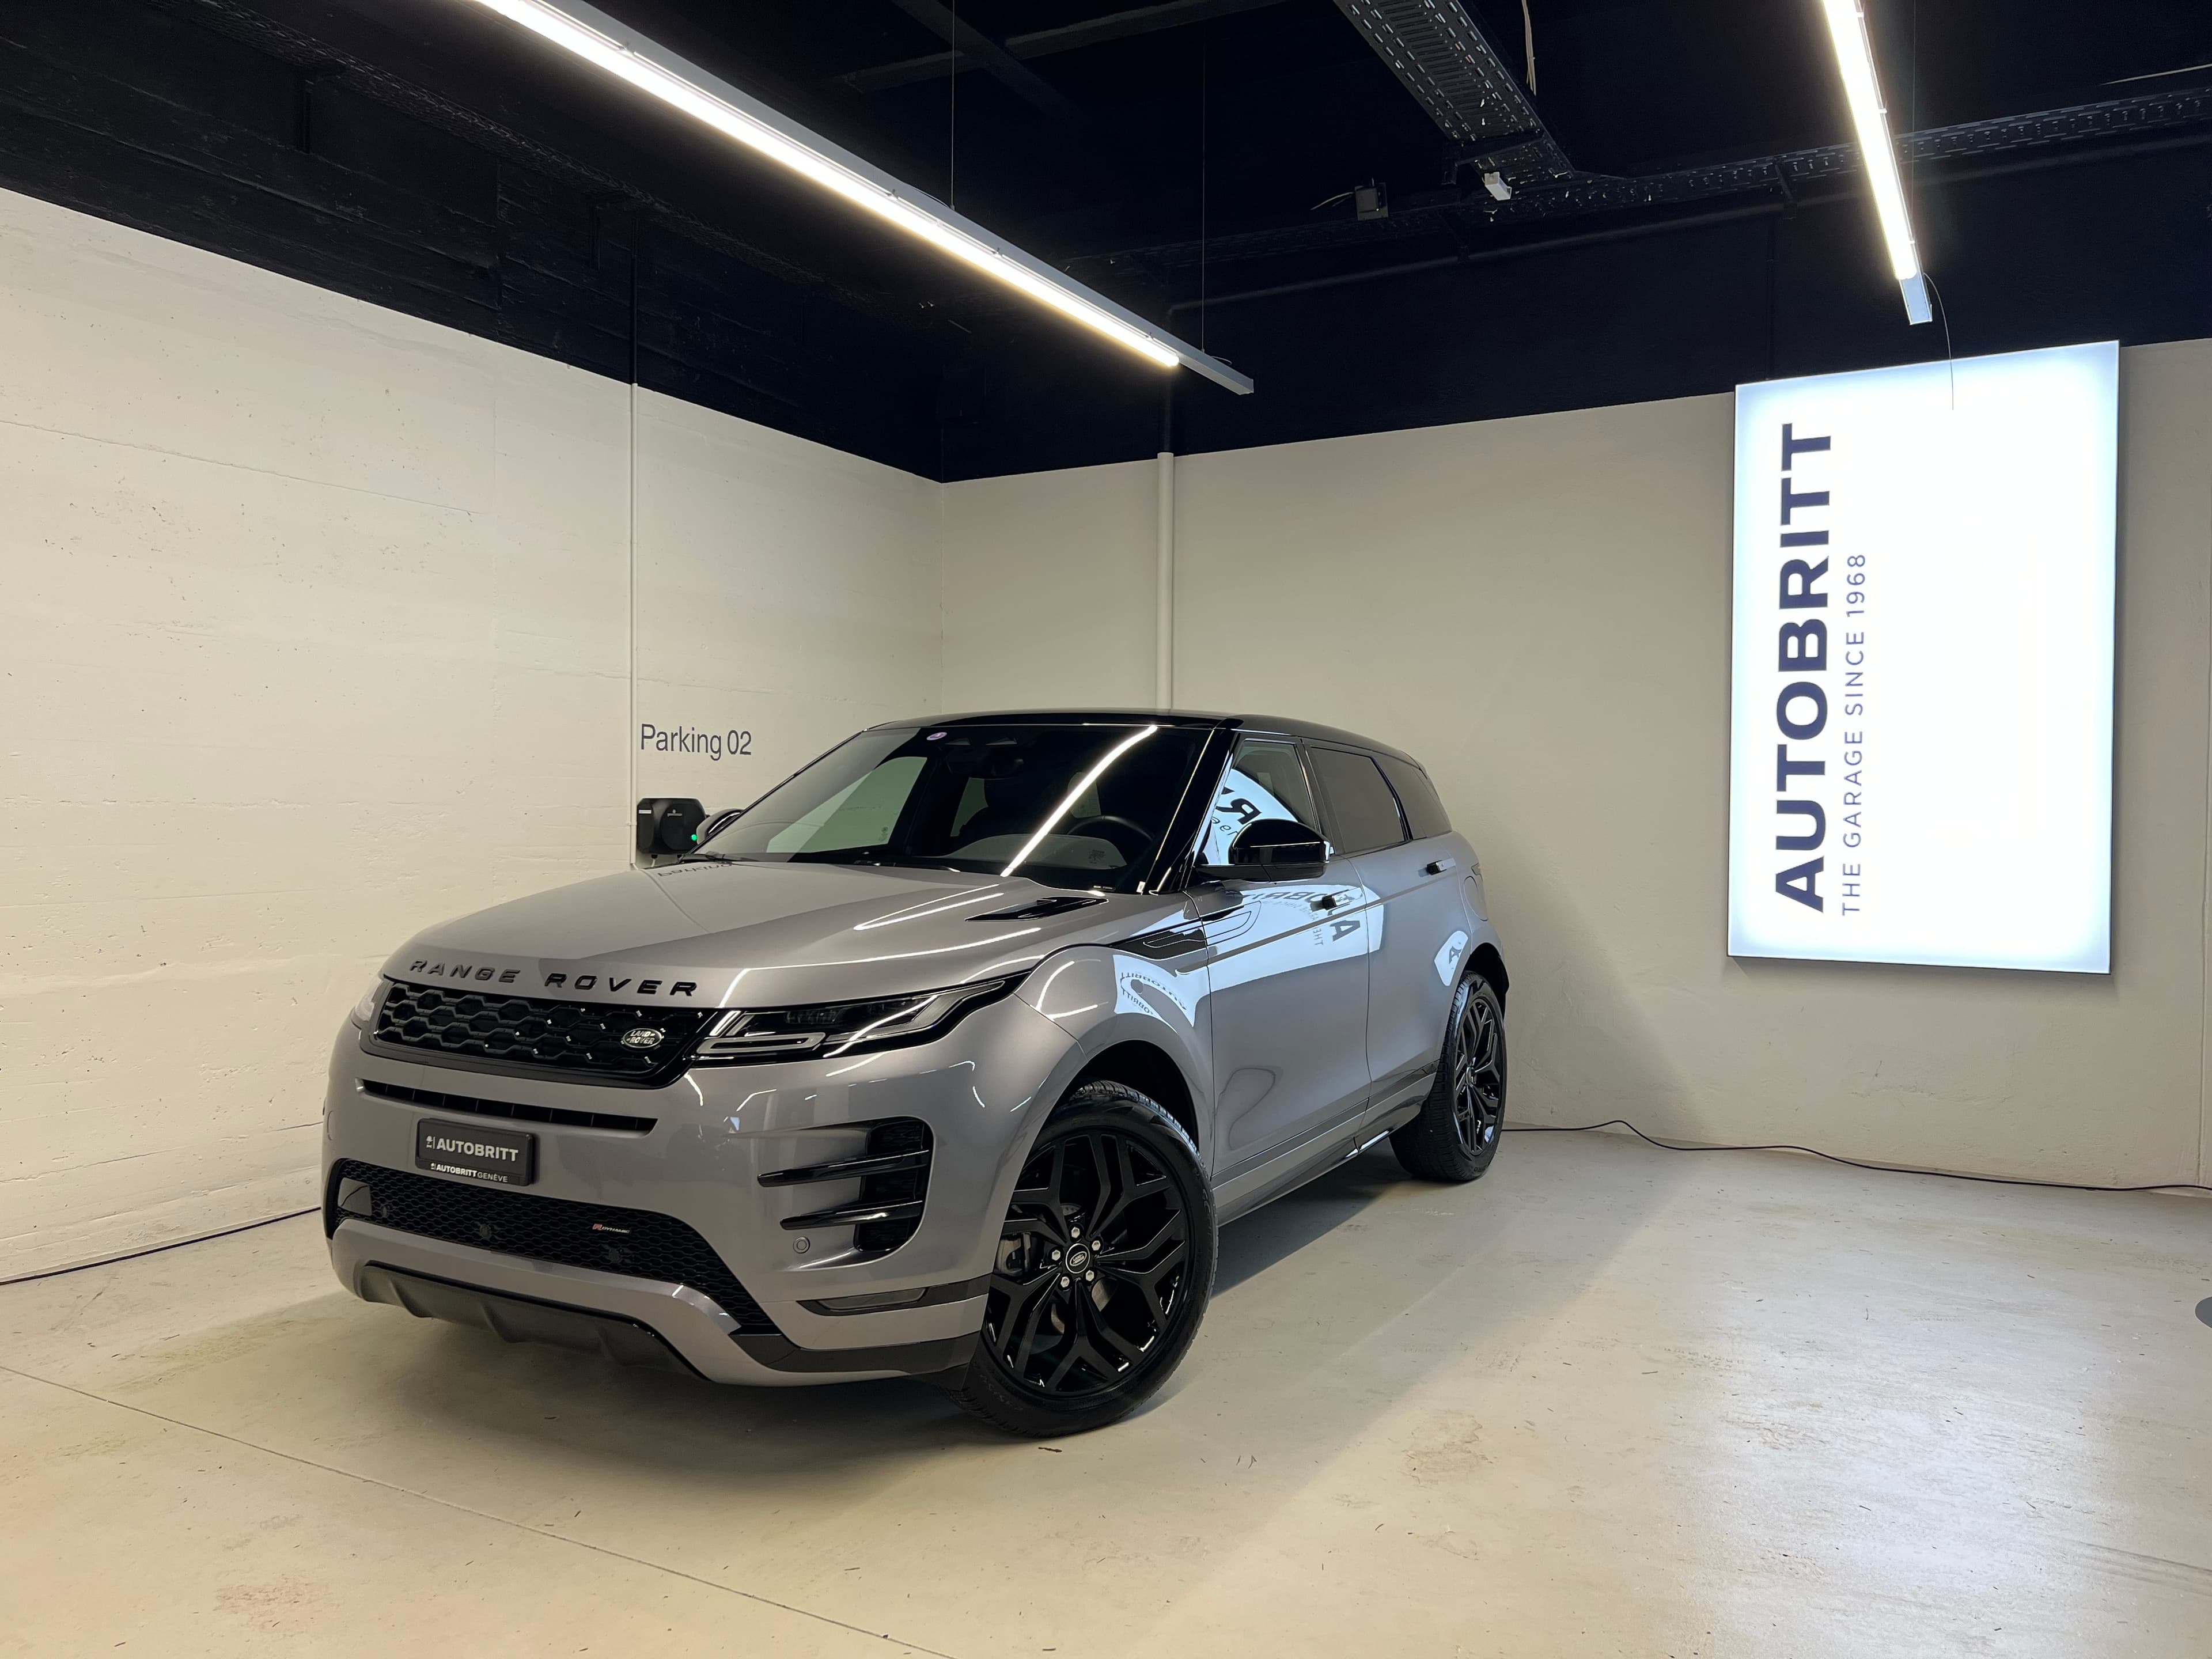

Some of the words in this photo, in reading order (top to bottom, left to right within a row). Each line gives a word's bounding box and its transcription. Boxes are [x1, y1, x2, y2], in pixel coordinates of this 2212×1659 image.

[1846, 555, 1866, 618] 1968
[1775, 423, 1831, 913] AUTOBRITT
[1844, 632, 1864, 716] SINCE
[641, 723, 721, 761] Parking
[727, 730, 752, 755] 02
[1842, 731, 1863, 848] GARAGE
[1842, 863, 1861, 916] THE
[410, 959, 521, 983] RANGE
[544, 973, 698, 997] ROVER
[629, 1036, 656, 1044] ROVER
[437, 1138, 518, 1162] AUTOBRITT
